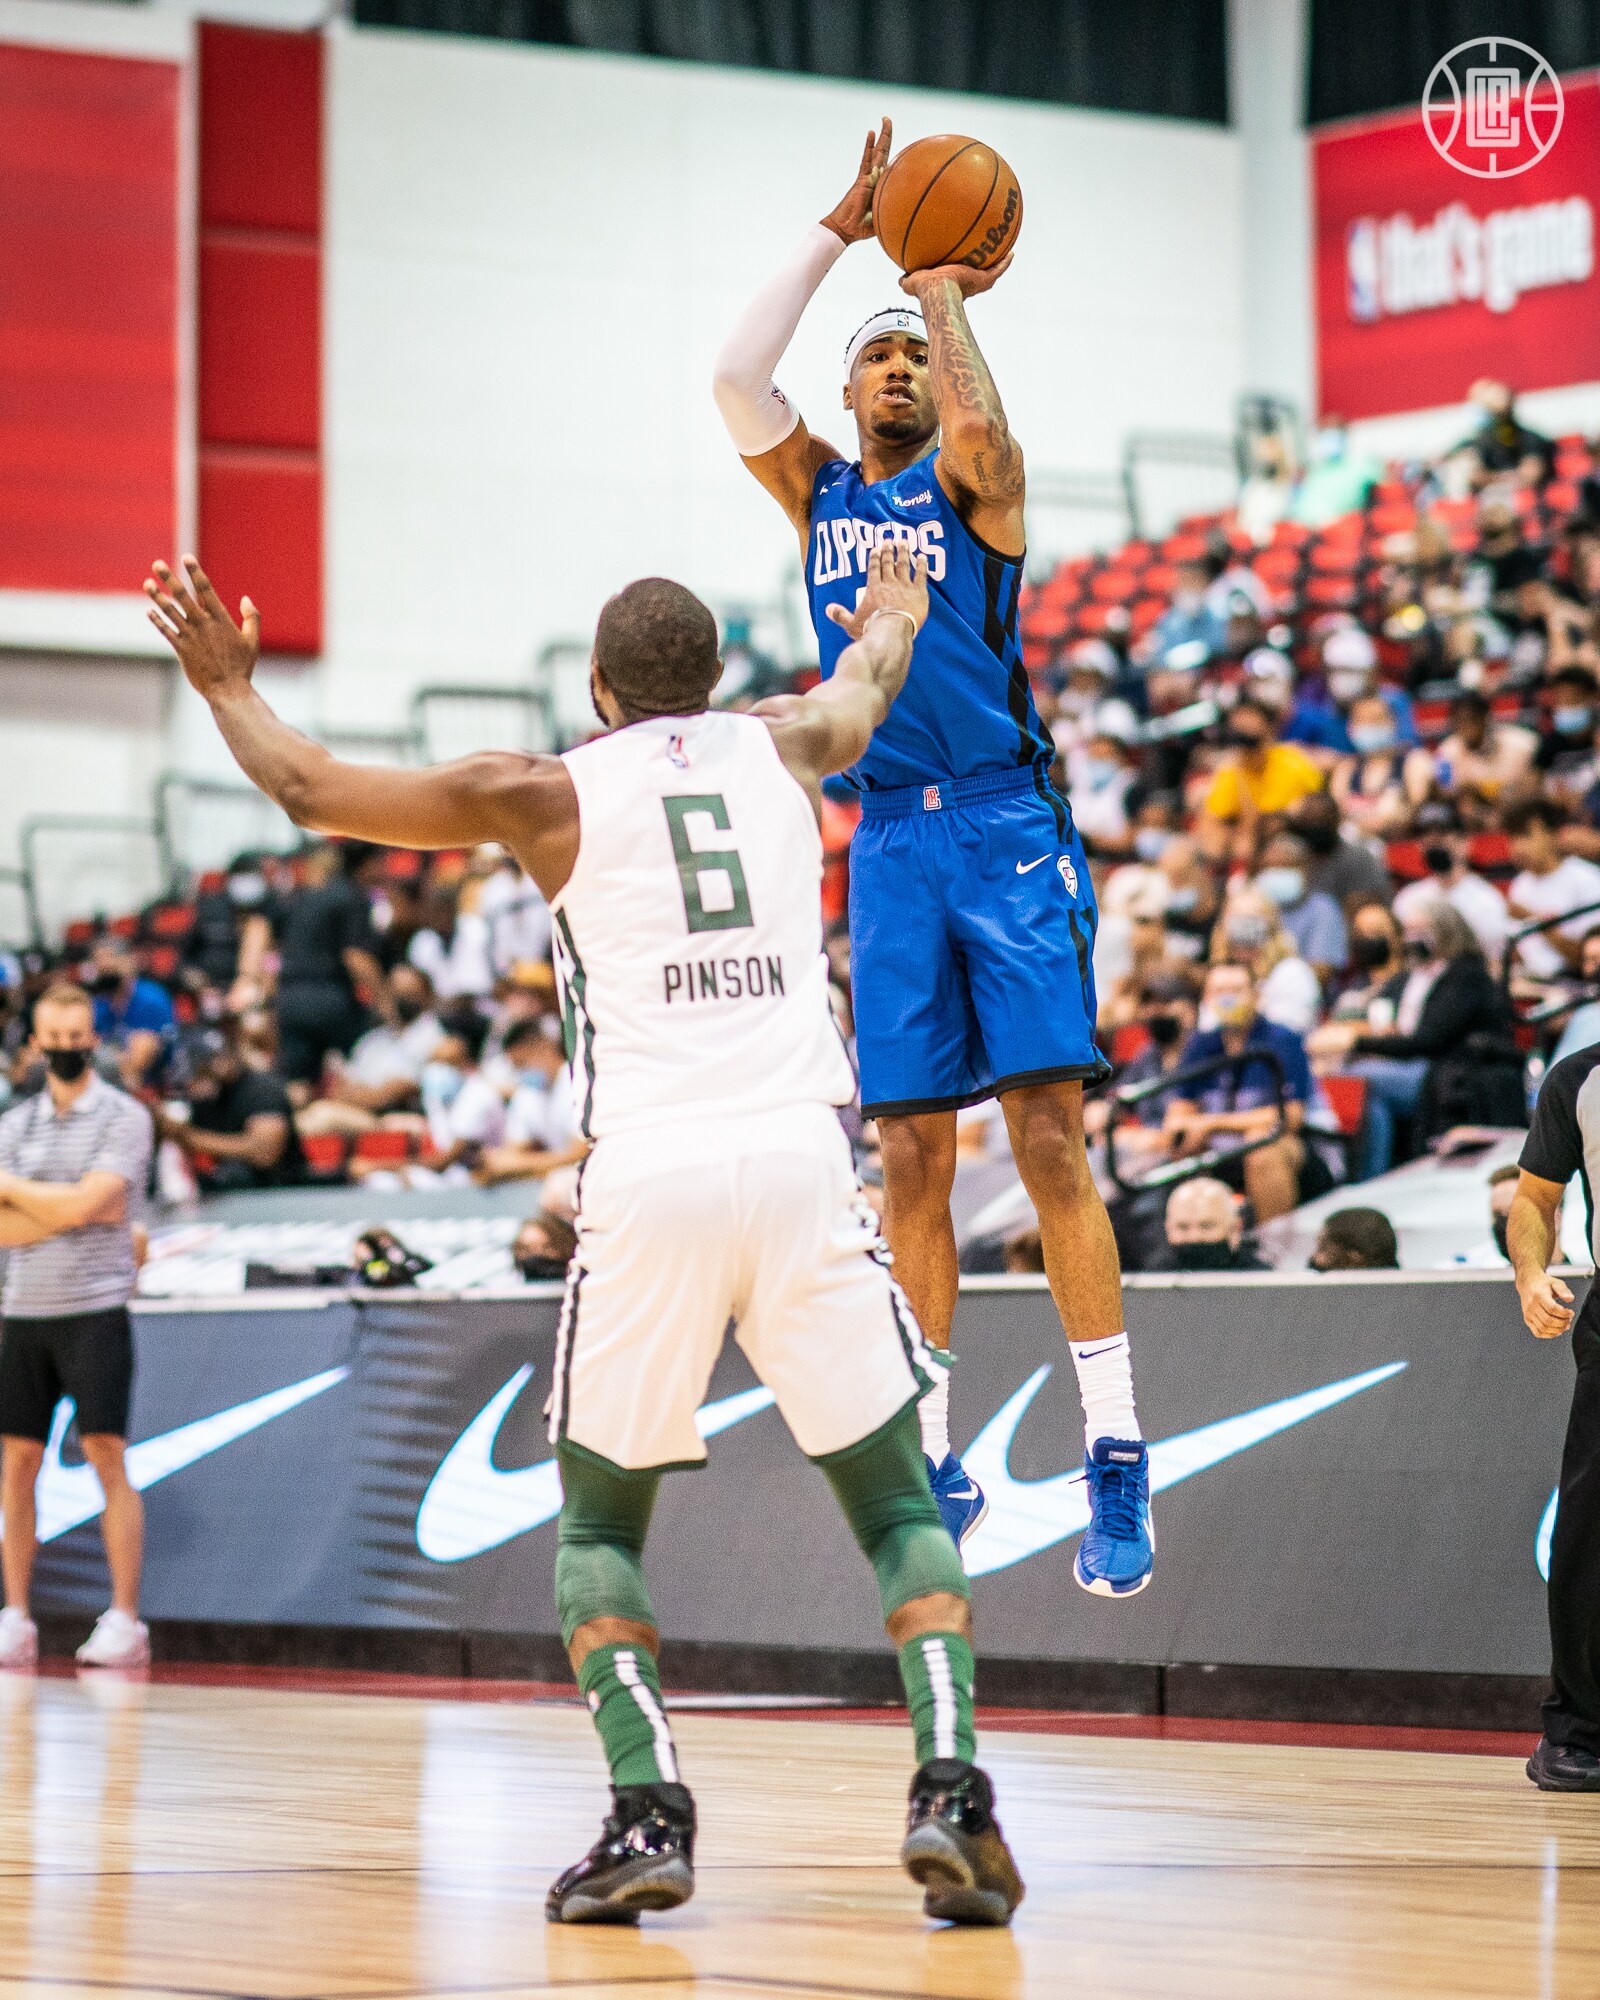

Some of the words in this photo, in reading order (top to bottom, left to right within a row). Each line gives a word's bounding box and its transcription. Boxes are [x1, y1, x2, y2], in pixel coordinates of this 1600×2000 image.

[962, 187, 1018, 269] Wilson
[661, 793, 755, 935] 6
[663, 955, 786, 1004] PINSON
